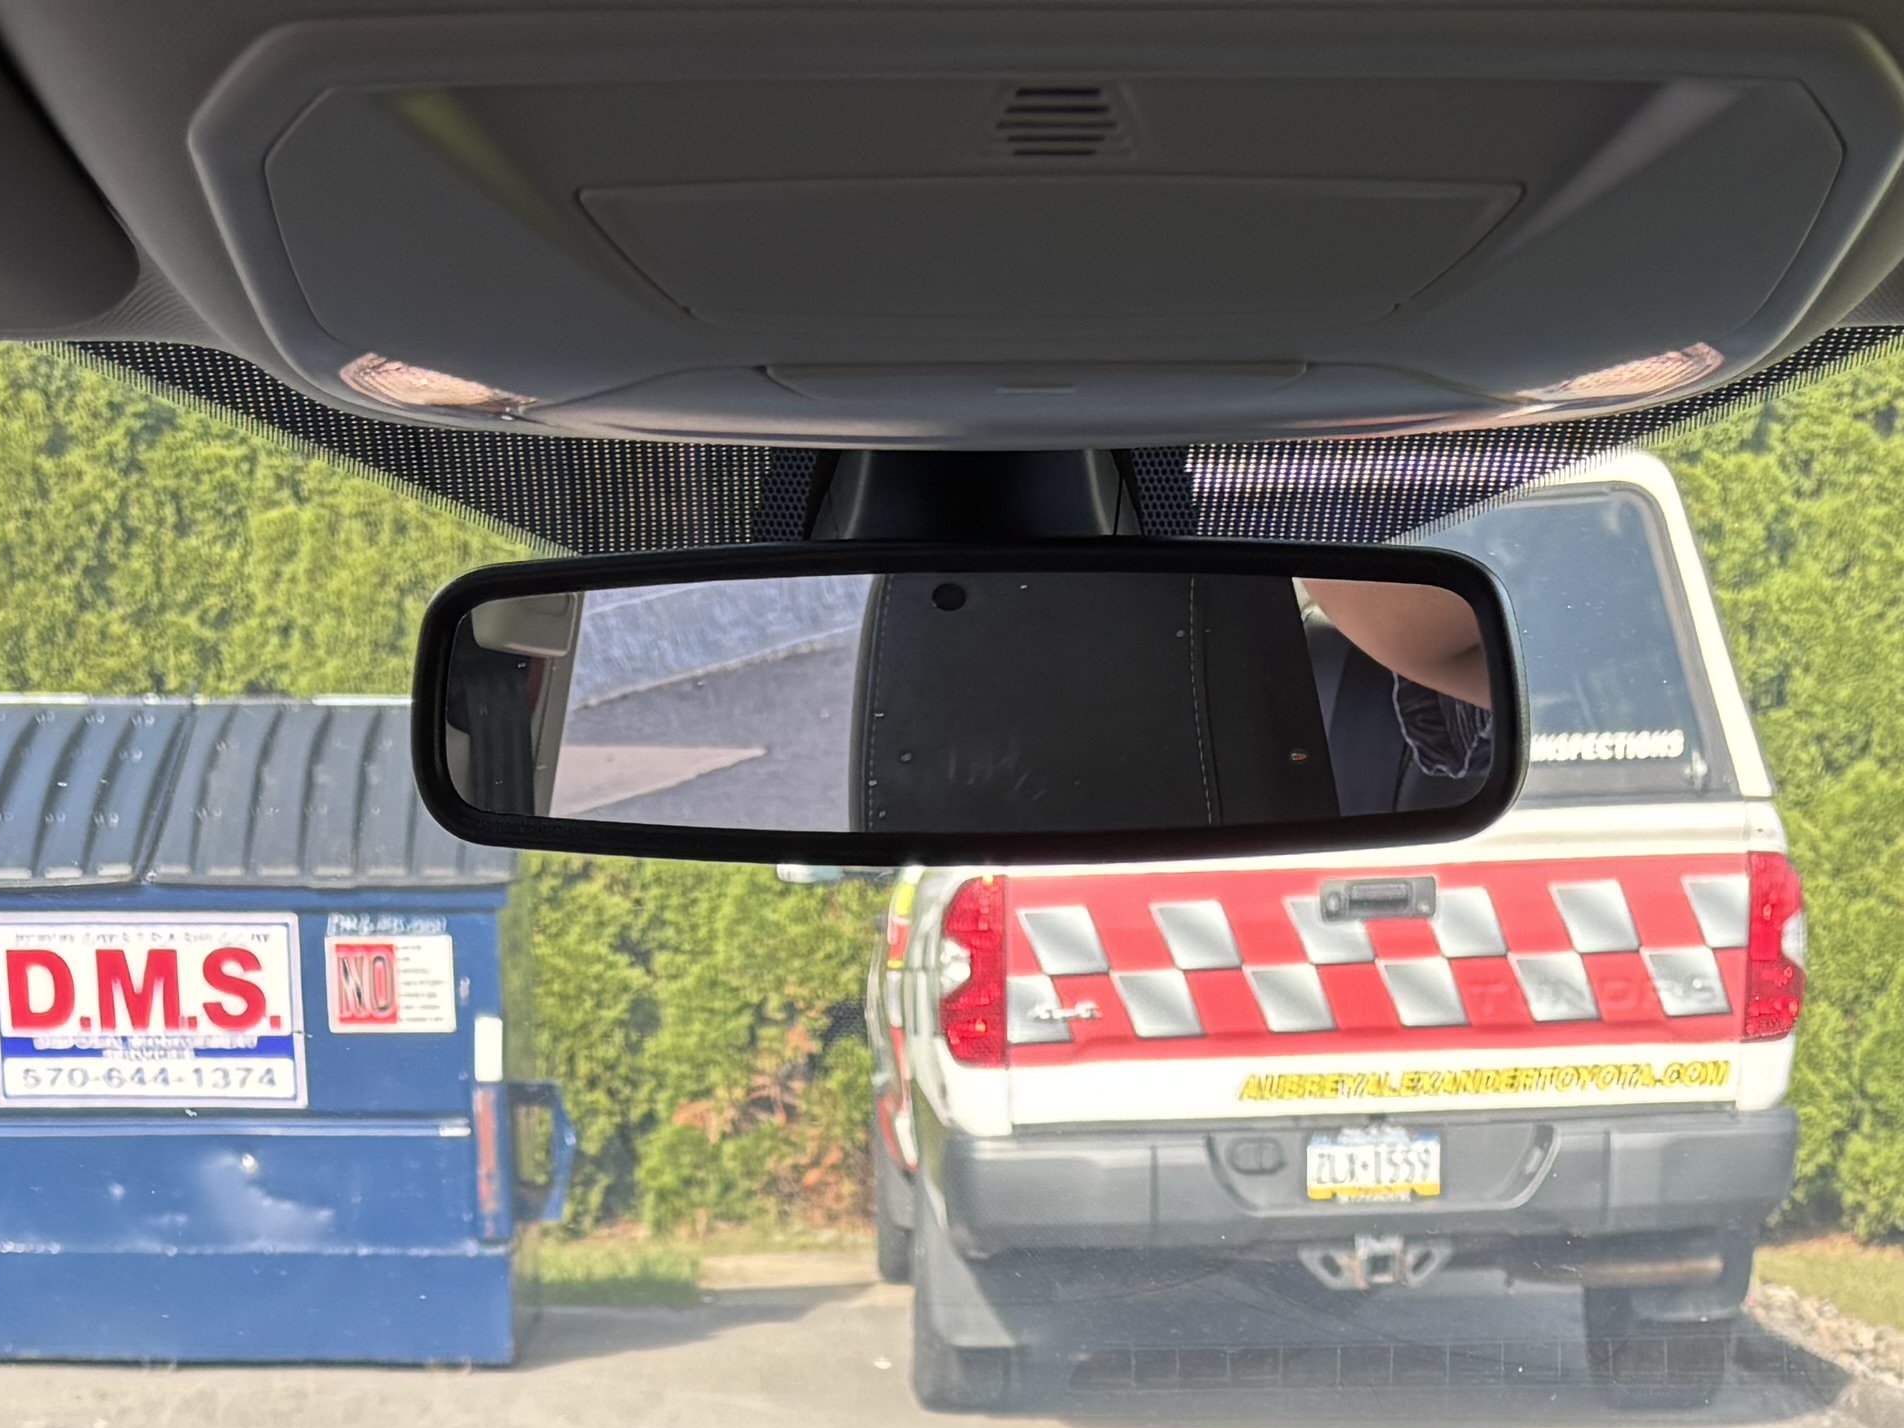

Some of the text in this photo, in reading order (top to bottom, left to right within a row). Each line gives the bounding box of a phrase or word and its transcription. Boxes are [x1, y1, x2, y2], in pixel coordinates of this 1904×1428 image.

[5, 947, 282, 1033] D.M.S.
[336, 952, 396, 1016] NO
[22, 1066, 277, 1089] 570-644-1374
